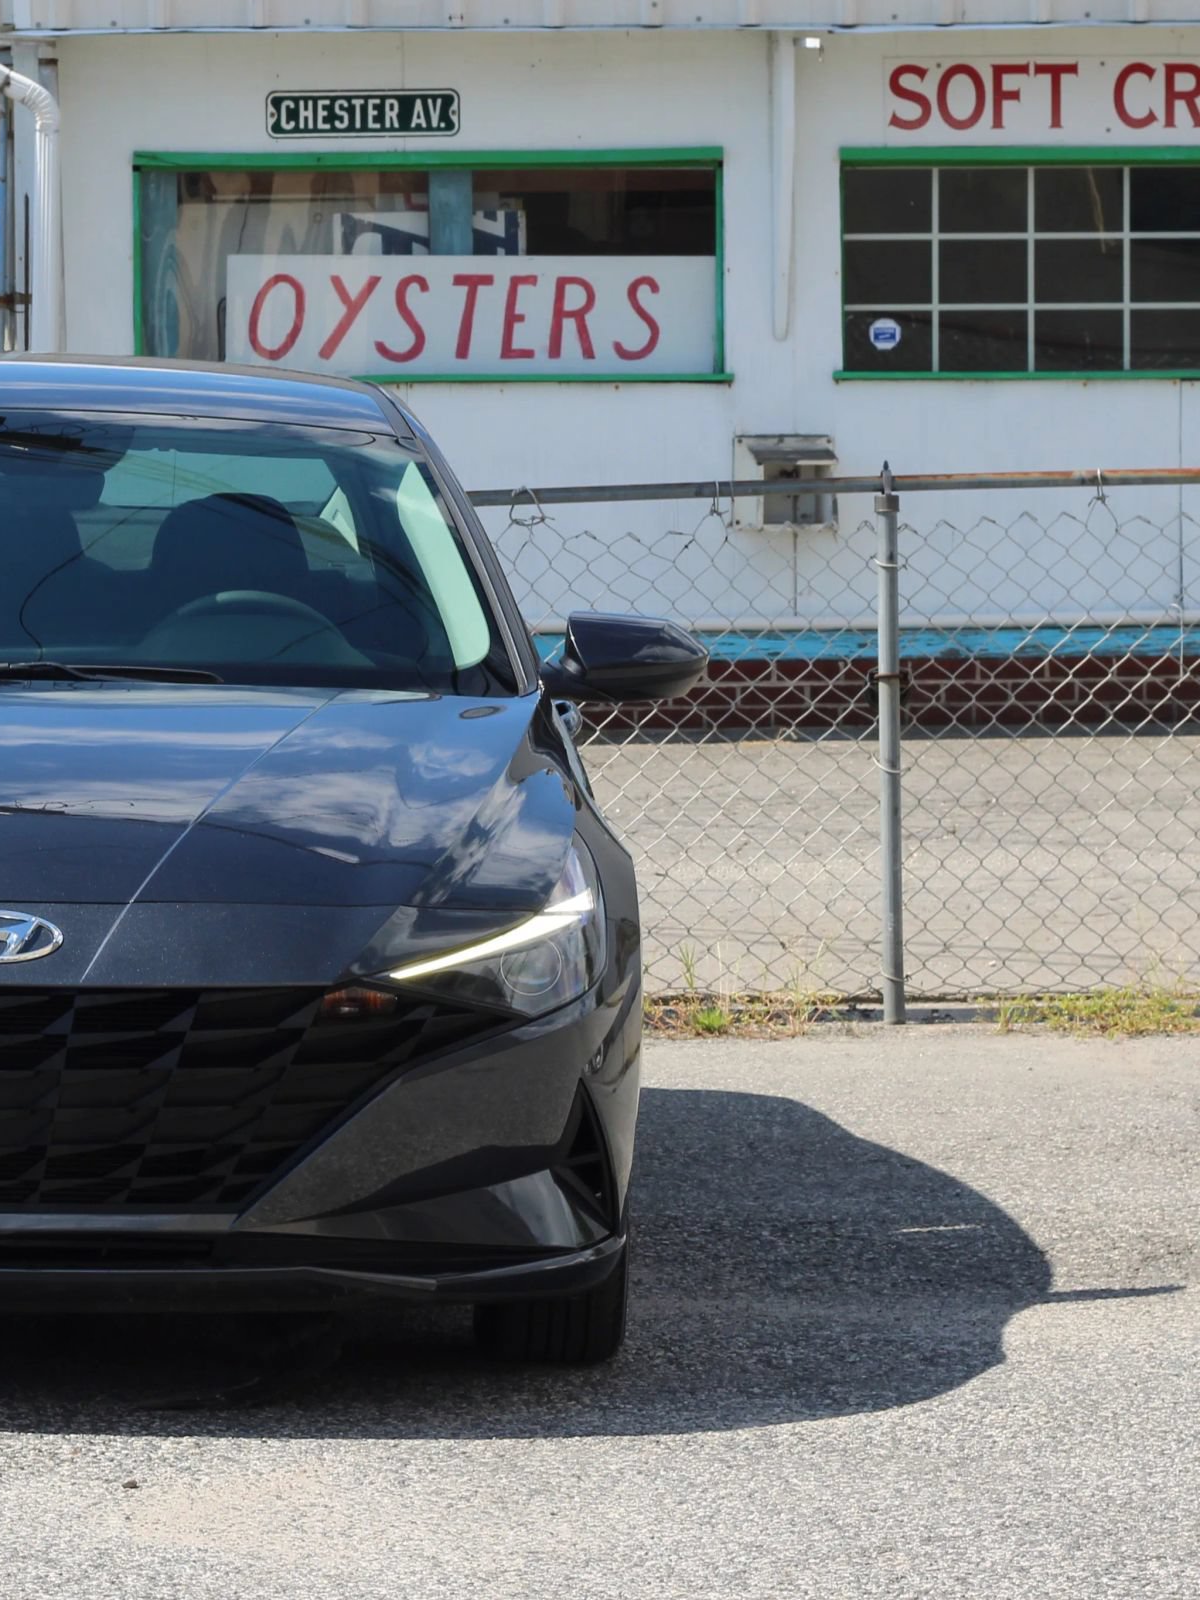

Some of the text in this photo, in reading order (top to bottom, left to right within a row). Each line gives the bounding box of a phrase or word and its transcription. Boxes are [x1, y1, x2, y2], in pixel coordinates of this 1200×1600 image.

[279, 97, 446, 130] CHESTER AV.
[888, 61, 1079, 130] SOFT
[248, 273, 661, 363] OYSTERS
